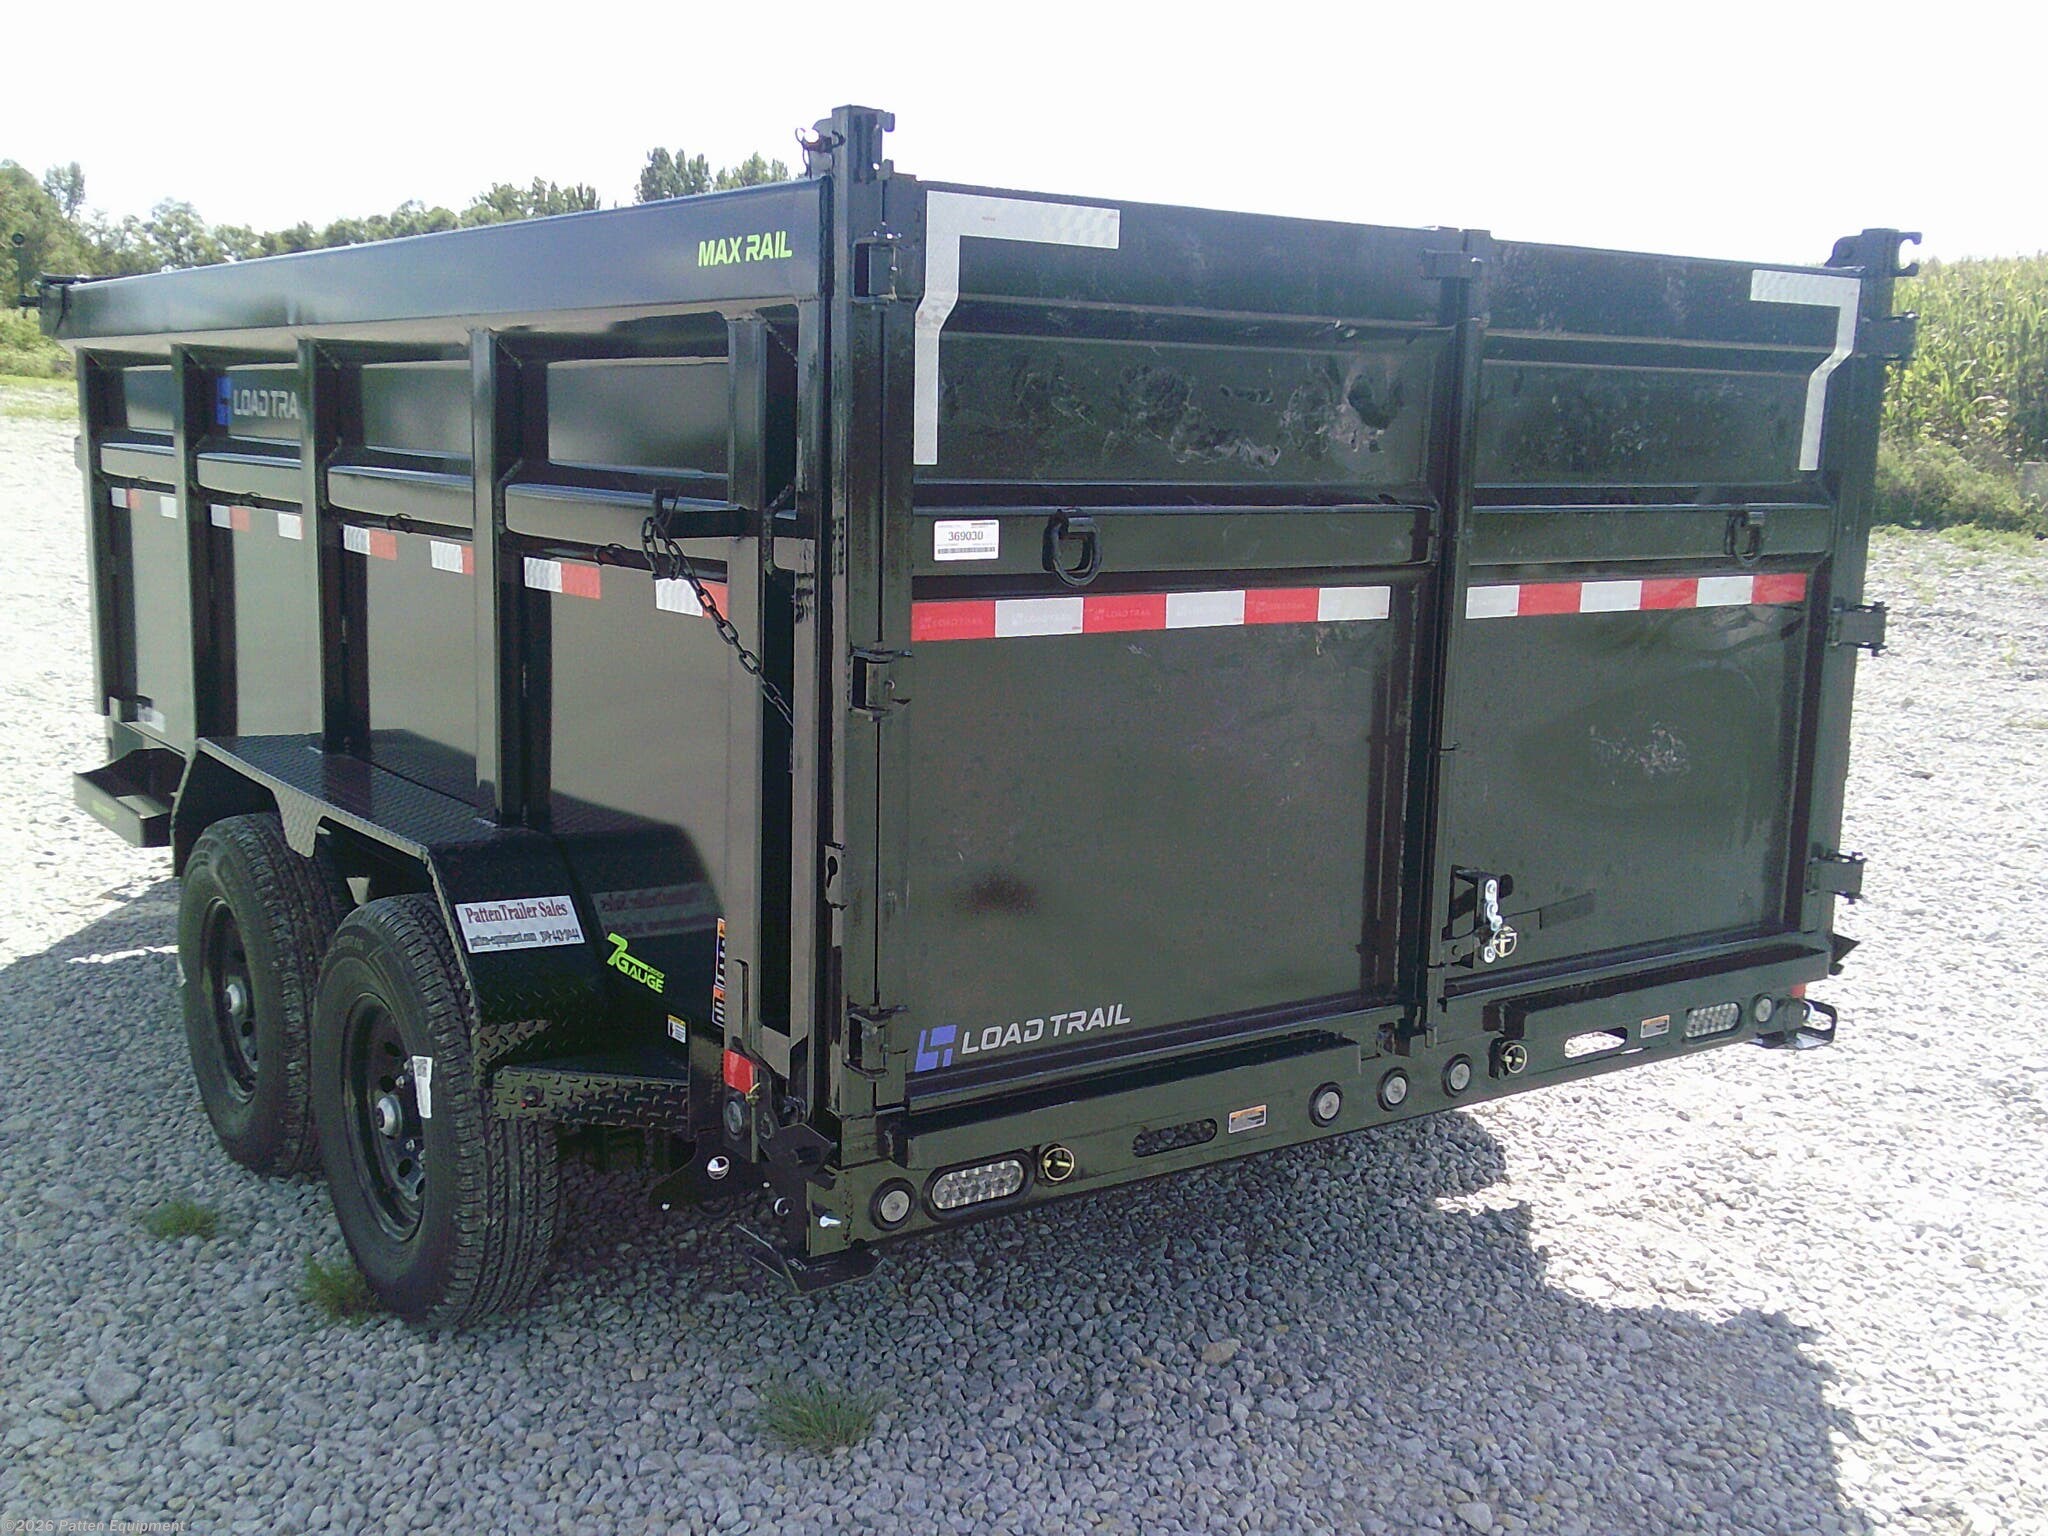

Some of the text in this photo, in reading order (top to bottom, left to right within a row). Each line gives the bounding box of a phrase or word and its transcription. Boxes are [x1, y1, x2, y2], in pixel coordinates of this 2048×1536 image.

[698, 230, 793, 267] MAX RAIL
[233, 388, 300, 420] LOAD TRA
[947, 530, 984, 543] 369030
[464, 899, 568, 924] Patten Trailer Sales
[606, 932, 629, 967] 7
[616, 951, 665, 994] GAUGE
[961, 1003, 1132, 1055] LOAD TRAIL
